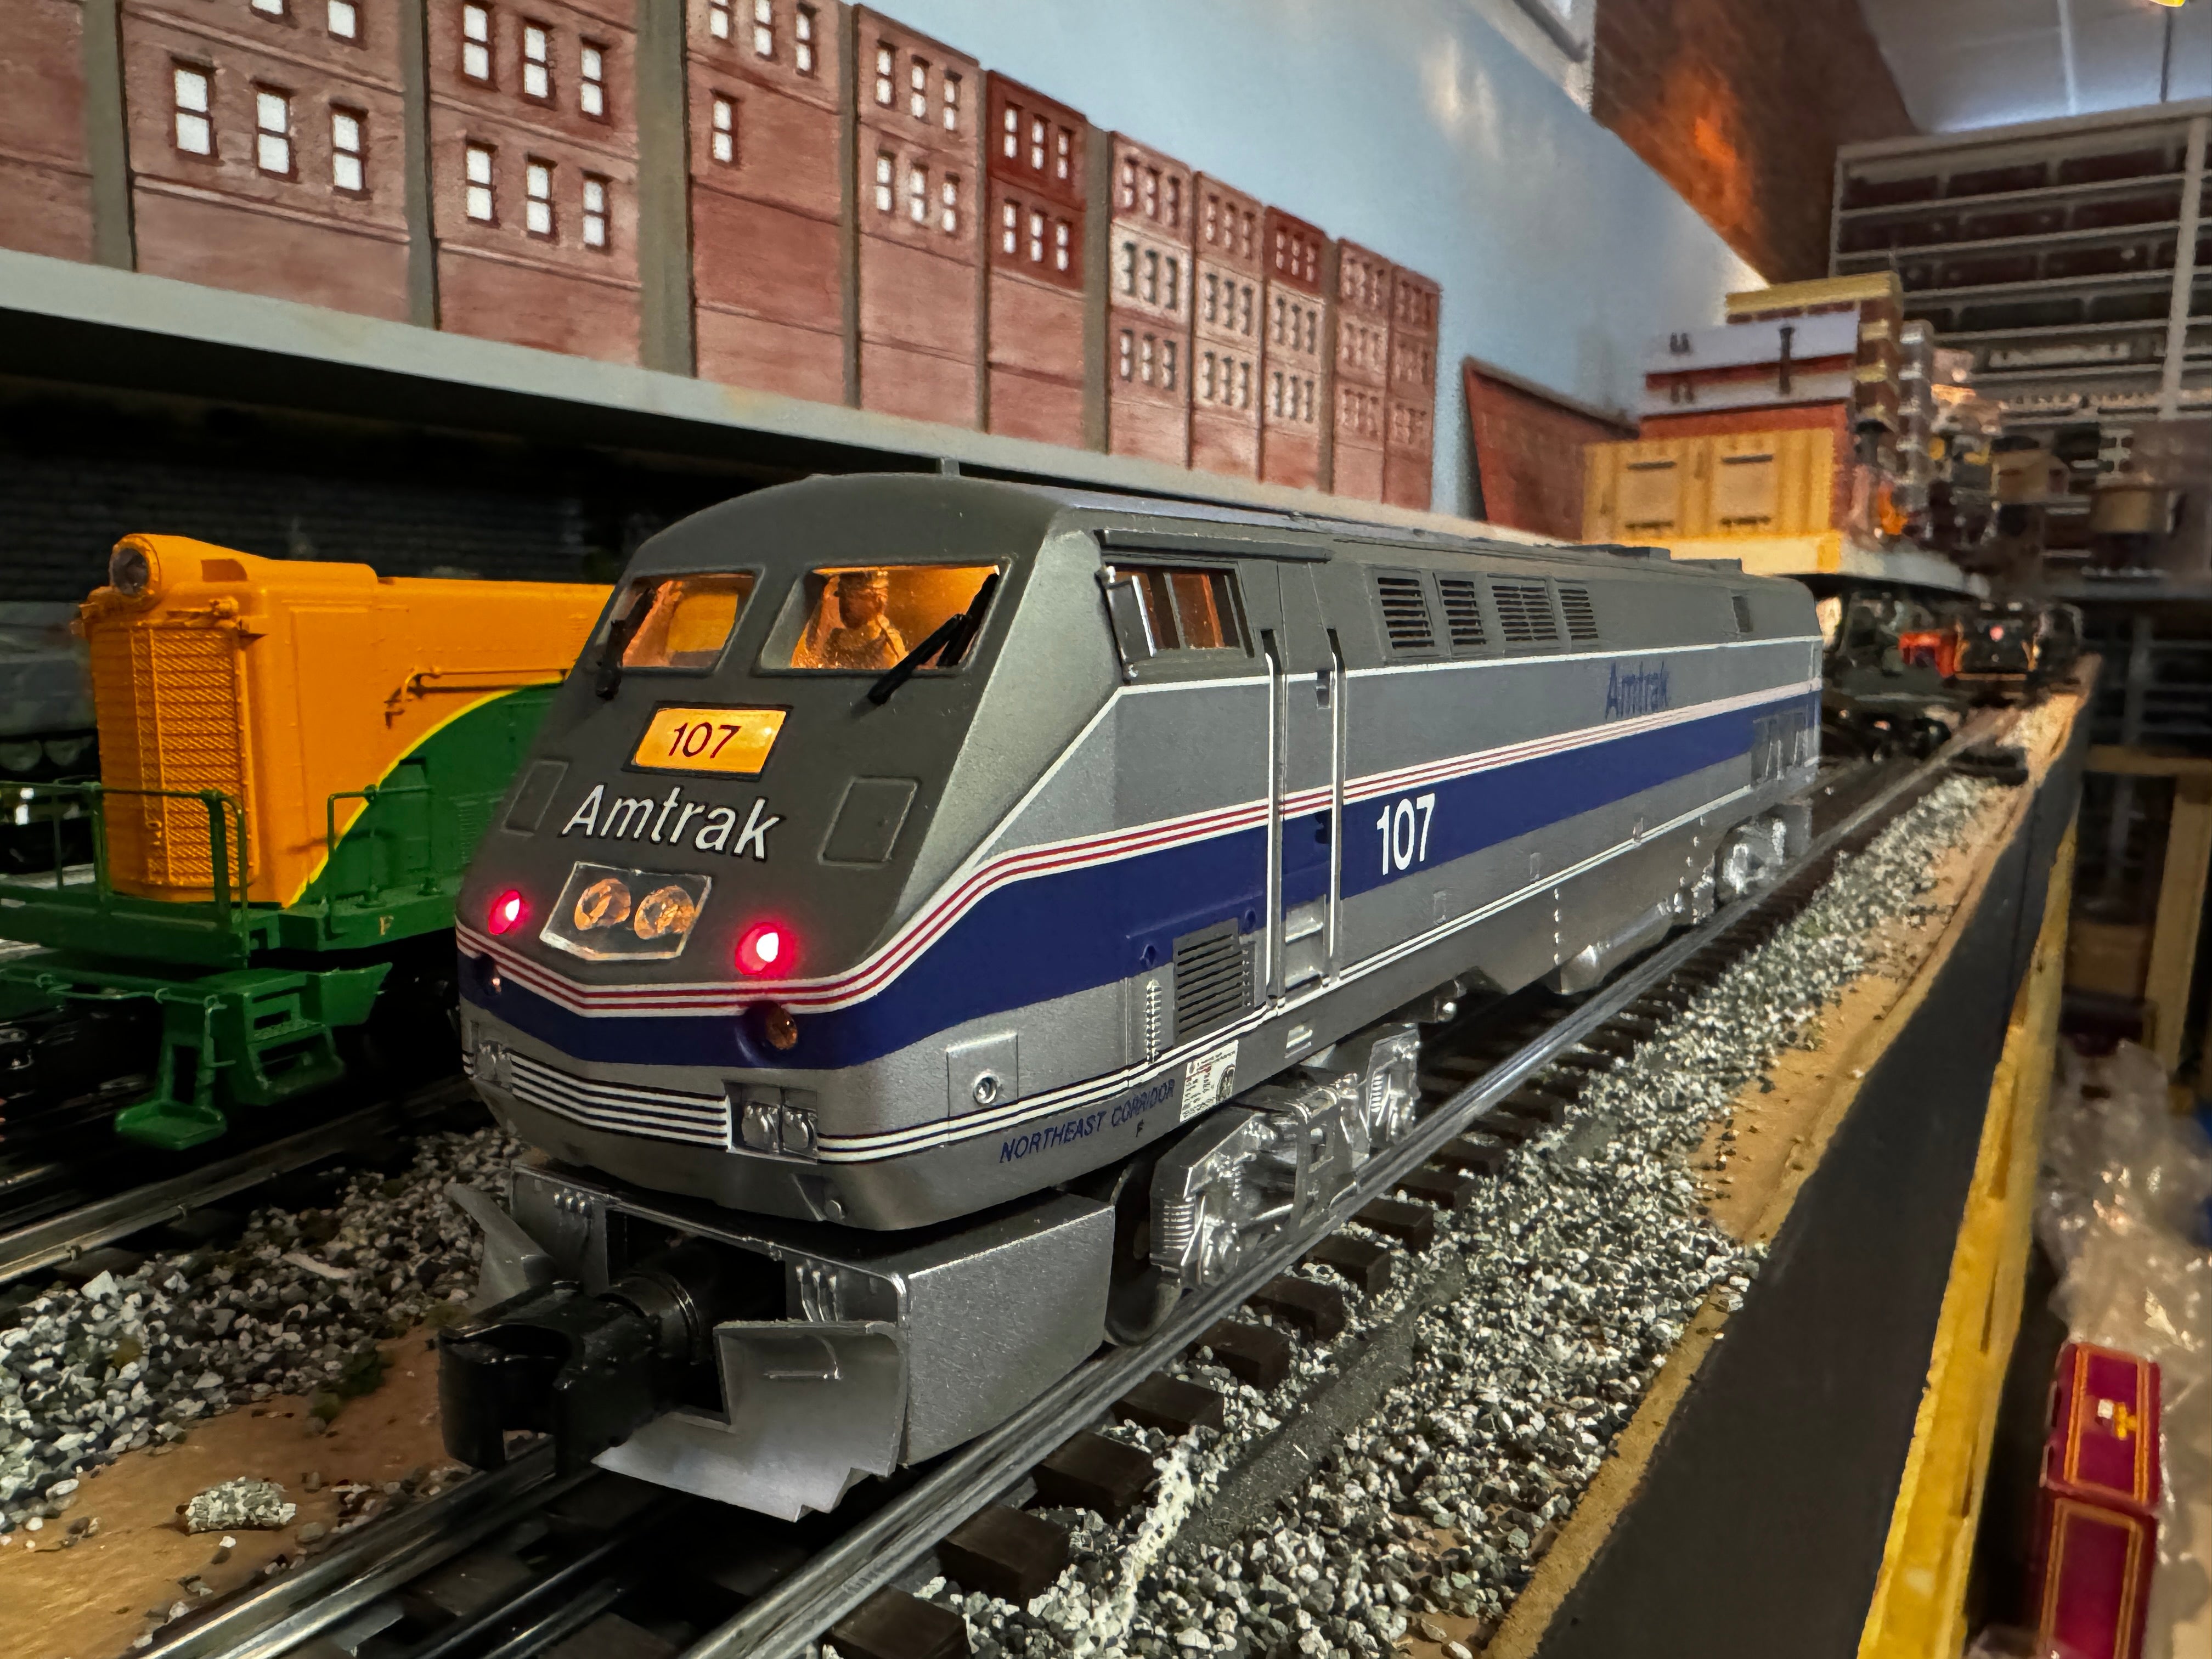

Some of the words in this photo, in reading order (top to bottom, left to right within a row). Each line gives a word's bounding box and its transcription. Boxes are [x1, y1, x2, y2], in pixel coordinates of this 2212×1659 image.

[668, 722, 742, 759] 107
[559, 783, 783, 861] Amtrak
[1376, 793, 1435, 876] 107
[999, 1110, 1107, 1163] NORTHEAST
[1111, 1078, 1175, 1128] CORRIDOR
[1136, 1119, 1145, 1138] F
